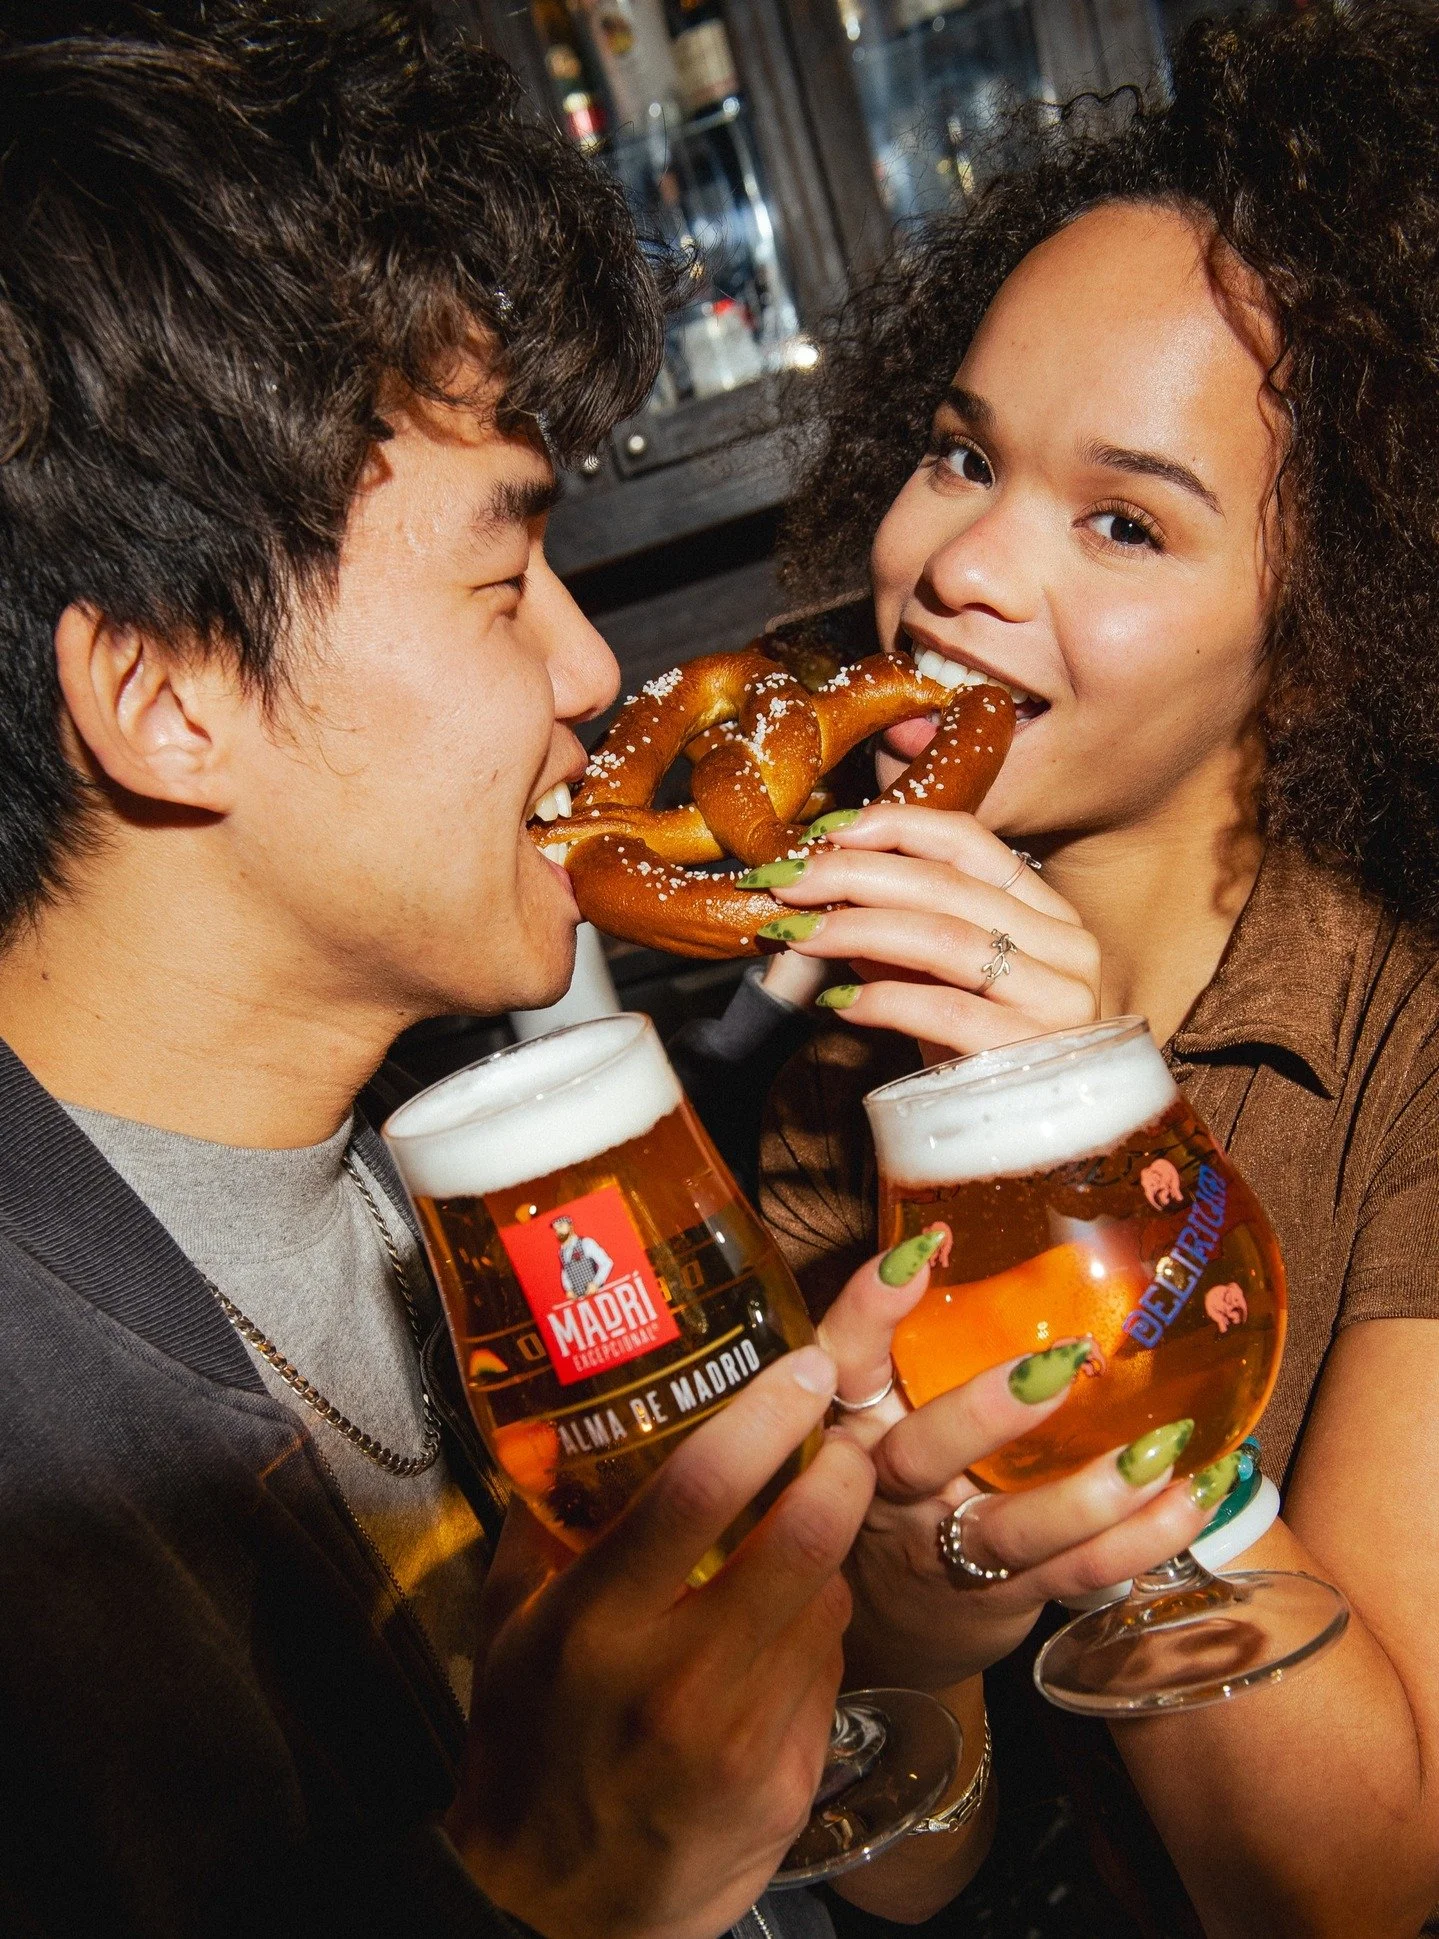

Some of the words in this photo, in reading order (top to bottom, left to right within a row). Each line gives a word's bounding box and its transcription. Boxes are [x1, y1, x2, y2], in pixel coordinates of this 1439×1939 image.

[1123, 1164, 1227, 1348] DELIRIUM
[558, 1409, 628, 1456] ALMA
[629, 1391, 668, 1430] DE
[669, 1338, 761, 1412] MADRID
